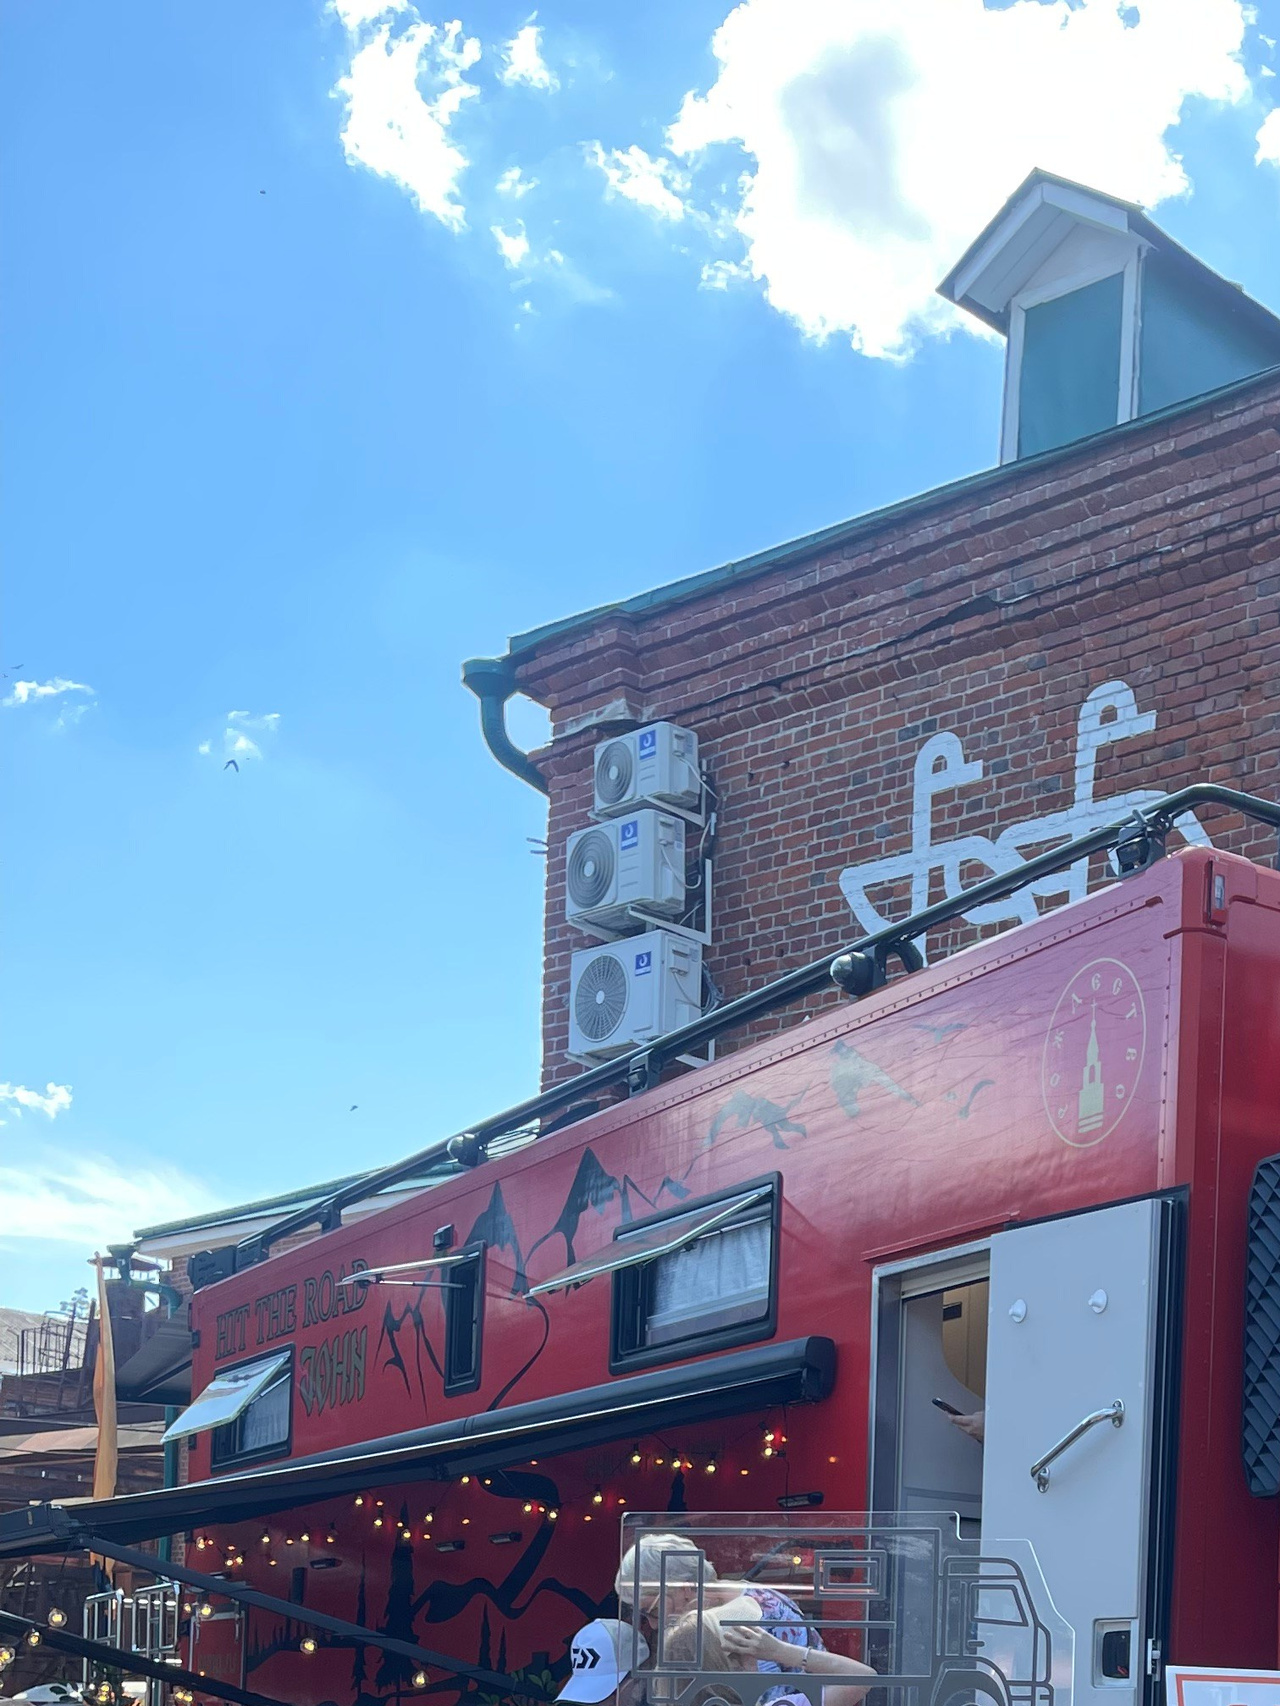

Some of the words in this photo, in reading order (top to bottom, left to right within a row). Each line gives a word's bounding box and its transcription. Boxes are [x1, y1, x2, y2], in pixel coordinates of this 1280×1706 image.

[215, 1303, 250, 1361] HIT
[255, 1284, 298, 1346] THE
[302, 1258, 369, 1329] ROAD
[300, 1325, 368, 1417] JOHN
